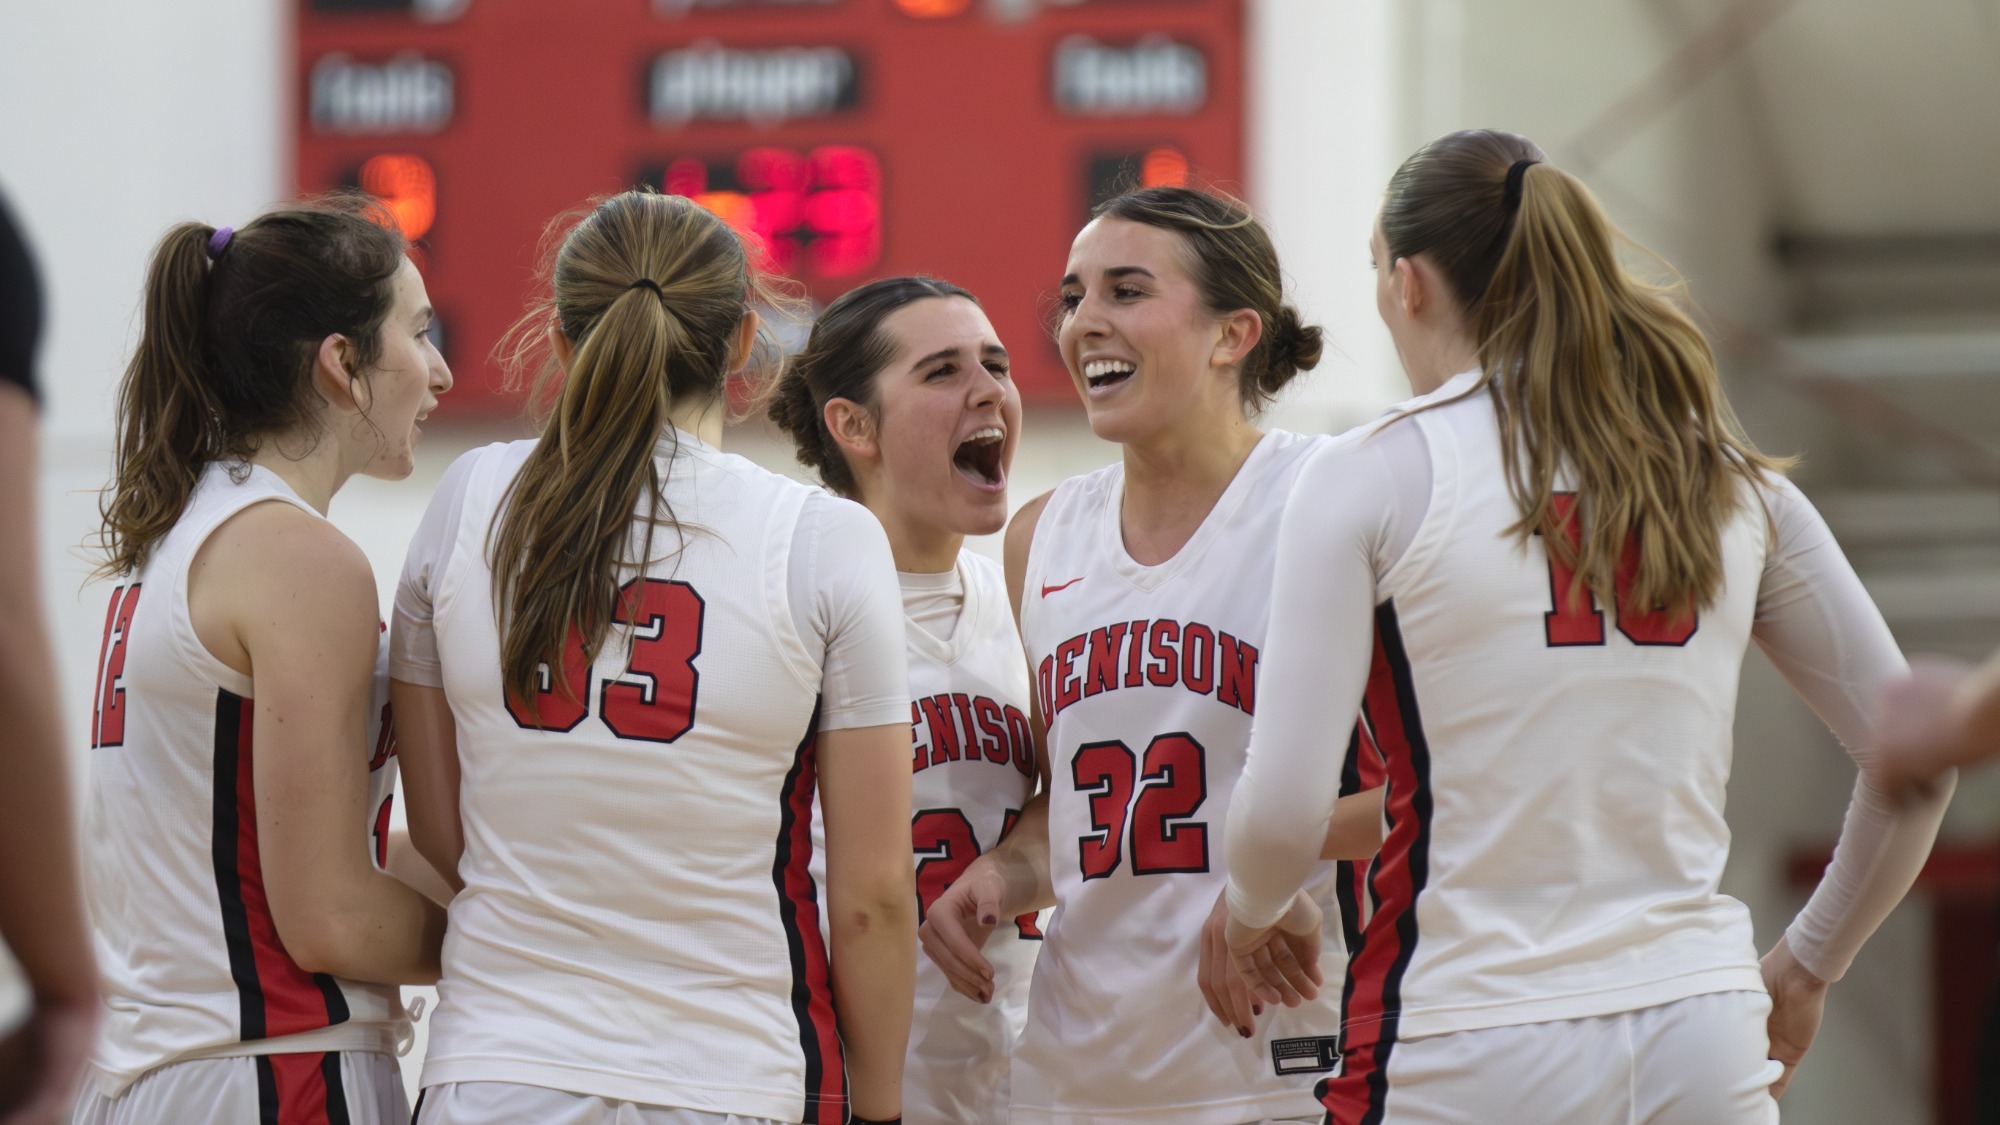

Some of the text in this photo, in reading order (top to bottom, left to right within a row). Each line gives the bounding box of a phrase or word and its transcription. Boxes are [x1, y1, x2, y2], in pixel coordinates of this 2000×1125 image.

[91, 582, 142, 749] 12
[1039, 618, 1259, 729] DENISON
[1071, 731, 1210, 882] 32
[1328, 1046, 1339, 1060] L
